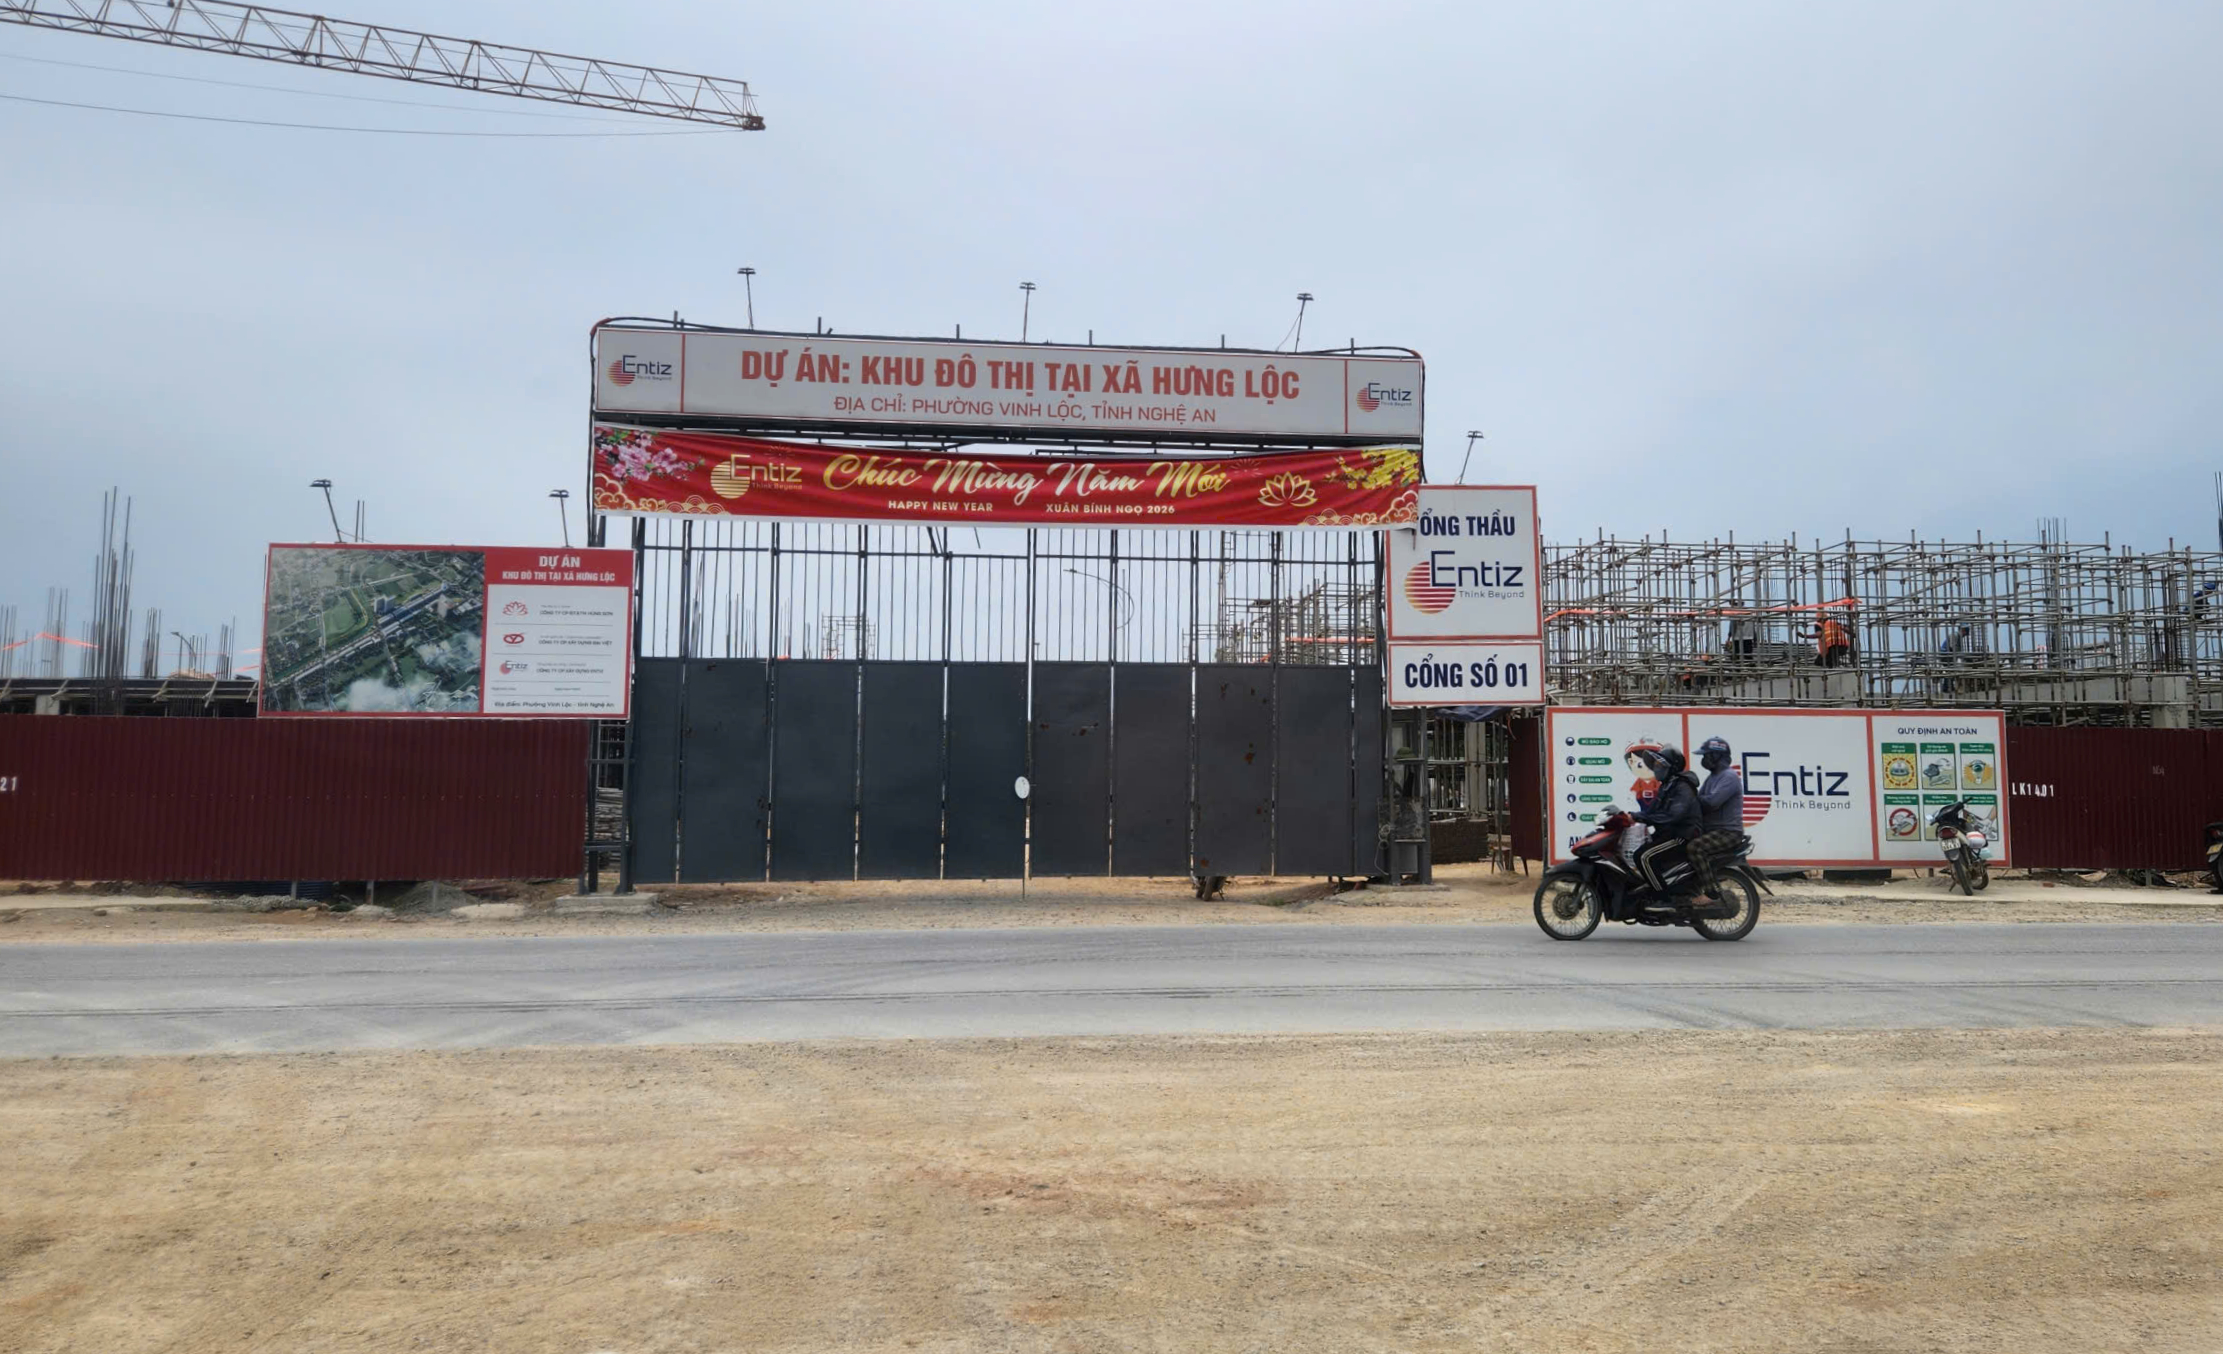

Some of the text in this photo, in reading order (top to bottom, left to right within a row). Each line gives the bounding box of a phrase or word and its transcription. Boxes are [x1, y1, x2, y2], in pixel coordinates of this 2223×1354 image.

[622, 354, 672, 375] Entiz
[742, 346, 1300, 404] DỰ ÁN: KHU ĐÔ THỊ TẠI XÃ HƯNG LỘC
[1368, 382, 1412, 401] Entiz
[834, 392, 1216, 424] ĐỊA CHỈ: PHƯỜNG VINH LỘC, TỈNH NGHỆ AN
[730, 454, 802, 482] Entiz
[823, 454, 1232, 505] Chúc Mừng Năm Mới
[888, 500, 993, 512] HAPPY NEW YEAR
[1046, 500, 1176, 516] XUÂN BÍNH NGỌ 2026
[1416, 508, 1516, 536] ỔNG THẦU
[539, 553, 580, 569] DỰ ÁN
[1431, 550, 1524, 587] Entiz
[502, 571, 518, 579] KHU
[534, 571, 546, 581] THỊ
[549, 572, 561, 582] TẠI
[600, 572, 616, 583] LỘC
[1488, 590, 1524, 600] Beyond
[1404, 653, 1528, 688] CỔNG SỐ 01
[1917, 727, 1938, 737] ĐỊNH
[1954, 726, 1978, 735] TOÀN
[1742, 752, 1850, 796] Entiz
[1775, 800, 1851, 811] Think Beyond
